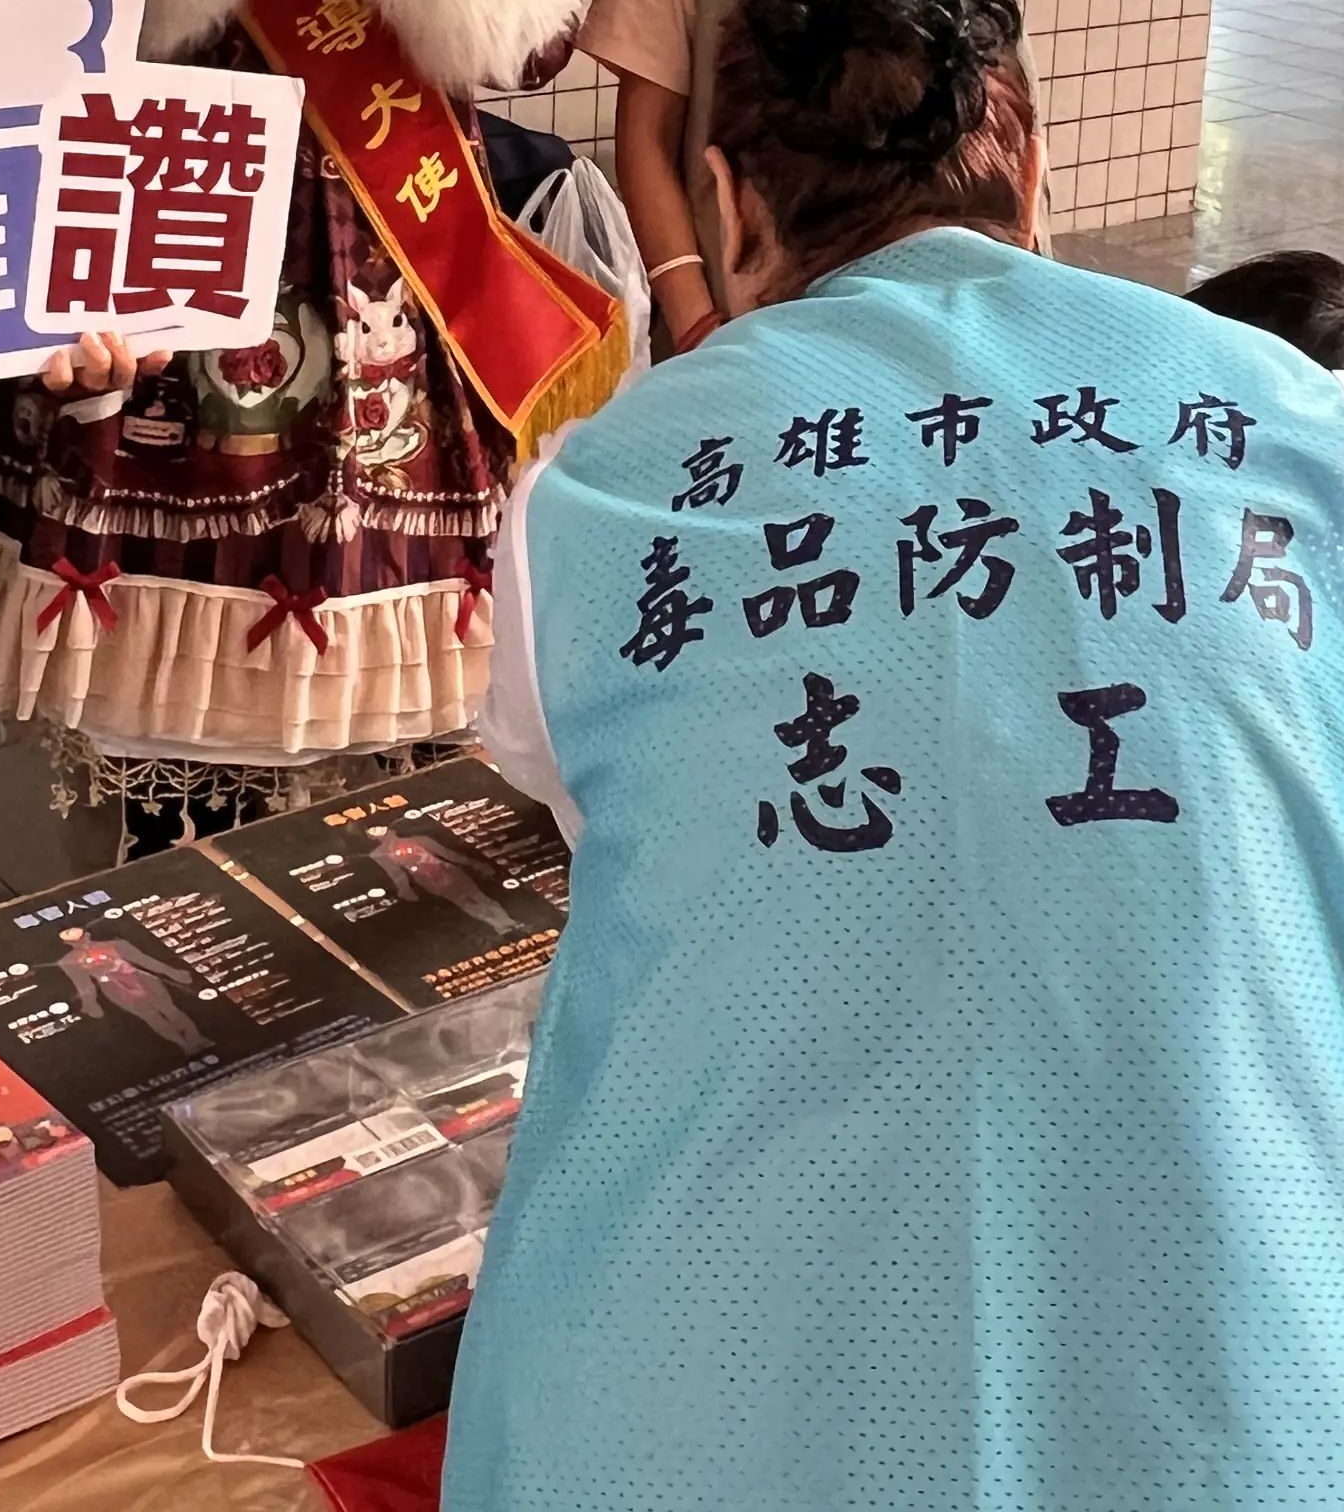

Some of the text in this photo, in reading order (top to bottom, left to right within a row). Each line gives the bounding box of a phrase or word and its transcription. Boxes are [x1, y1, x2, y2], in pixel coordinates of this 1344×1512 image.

[46, 93, 267, 320] 讚
[671, 385, 1257, 513] 高雄市政府
[618, 487, 1314, 673] 毒品防制局
[757, 671, 1179, 853] 志工
